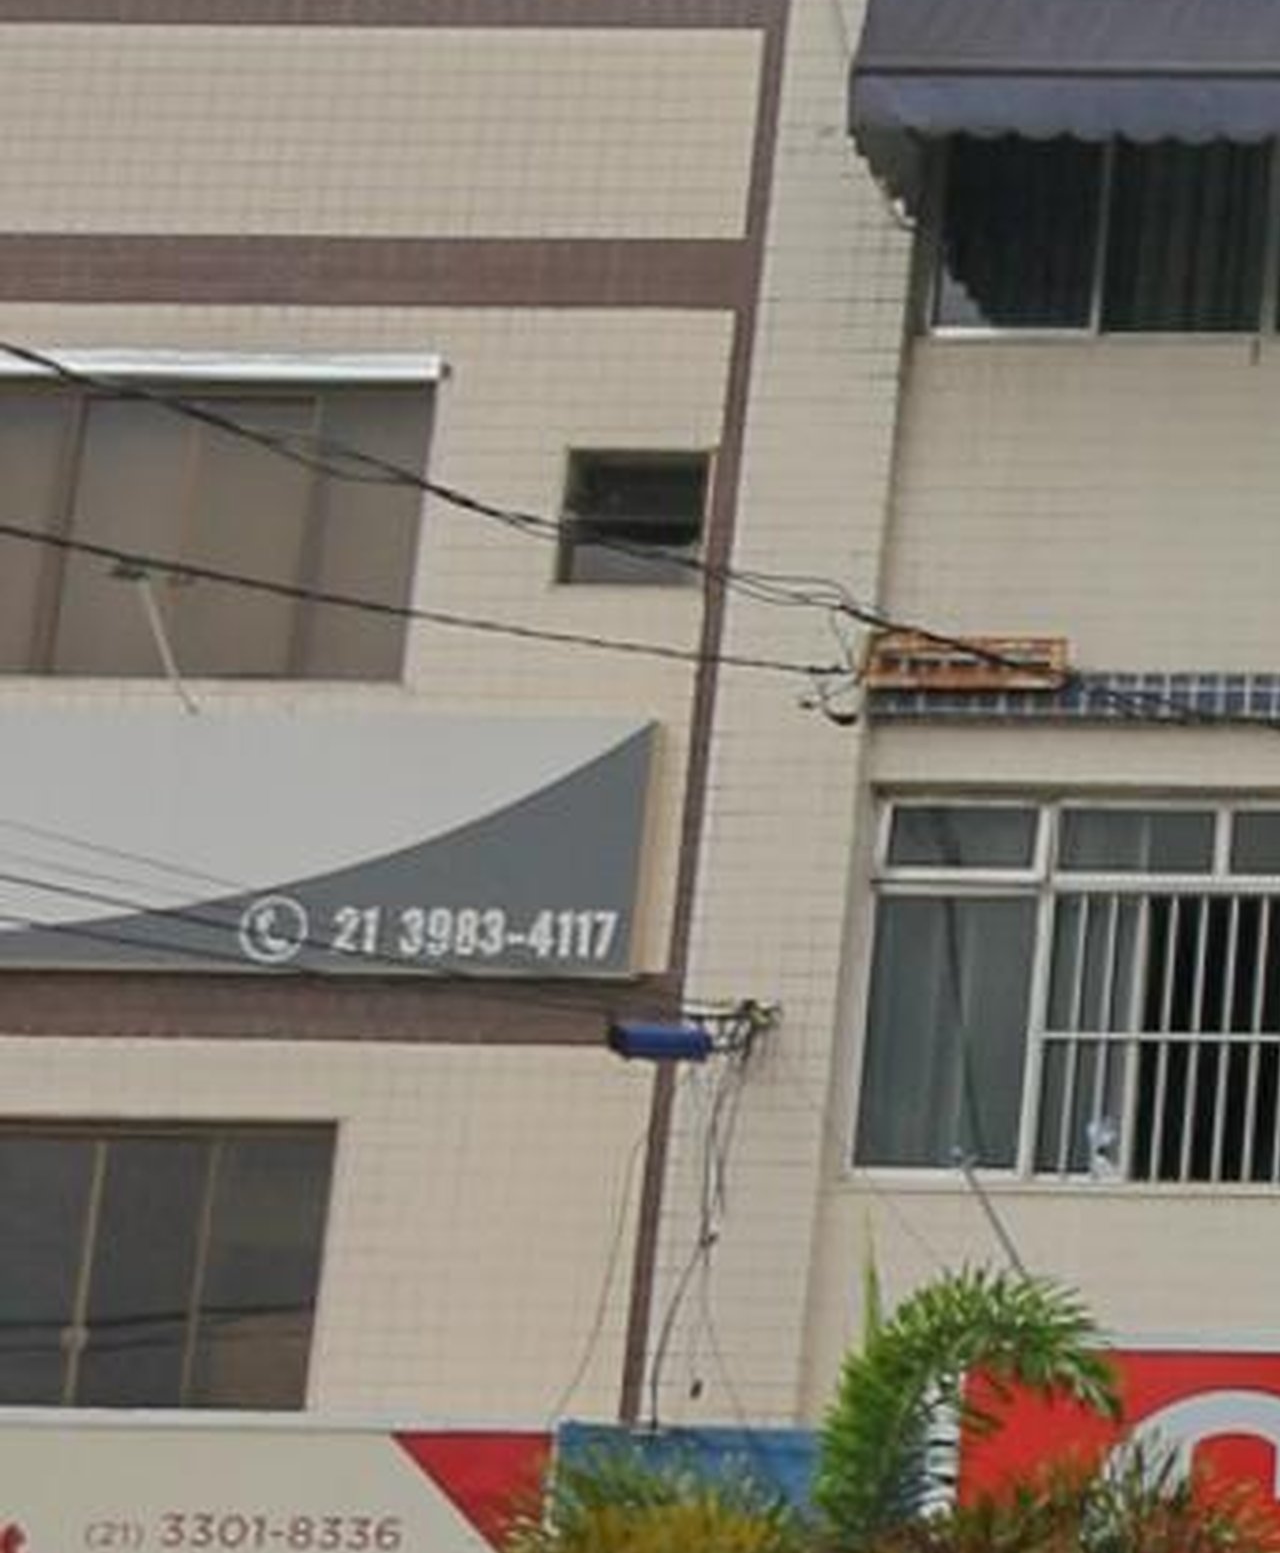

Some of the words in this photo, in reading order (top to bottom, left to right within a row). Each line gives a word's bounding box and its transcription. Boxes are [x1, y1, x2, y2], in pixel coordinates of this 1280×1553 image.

[333, 905, 382, 953] 21
[84, 1521, 144, 1551] (21)
[160, 1511, 402, 1551] 3301-8336
